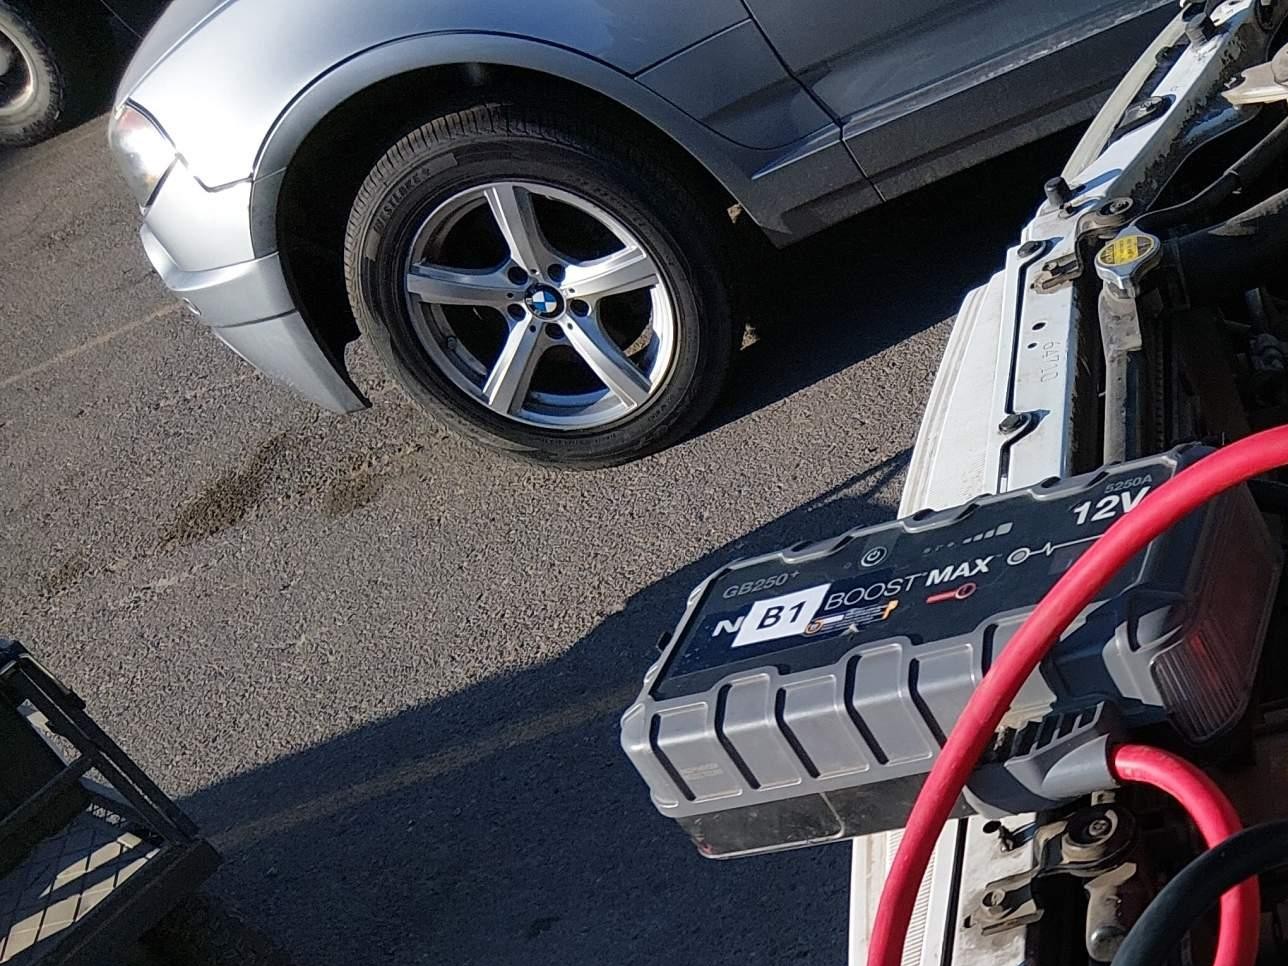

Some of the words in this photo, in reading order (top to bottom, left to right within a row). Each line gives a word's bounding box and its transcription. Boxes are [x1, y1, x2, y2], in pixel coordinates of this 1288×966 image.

[1104, 474, 1153, 494] 5250A
[1073, 486, 1152, 525] 12V
[722, 570, 801, 600] GB250+
[823, 573, 922, 611] BOOST
[925, 555, 995, 587] MAX
[755, 600, 807, 631] B1
